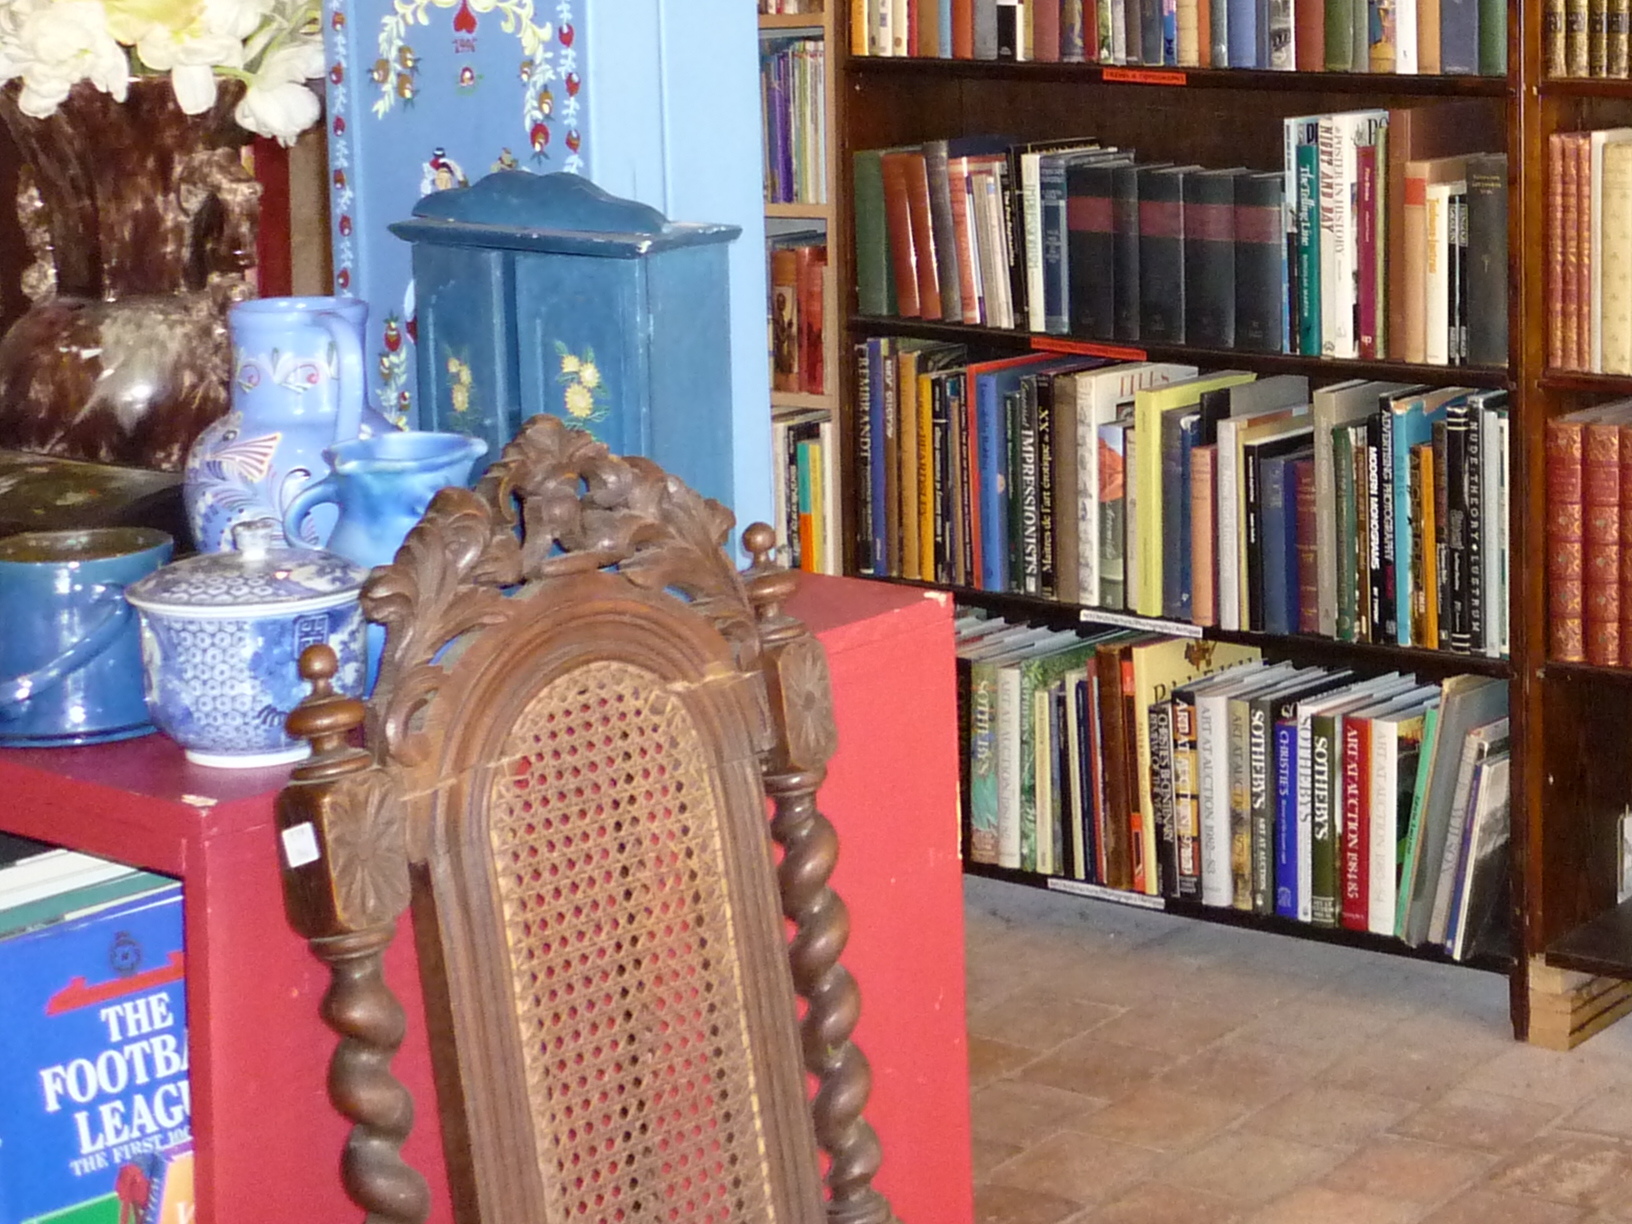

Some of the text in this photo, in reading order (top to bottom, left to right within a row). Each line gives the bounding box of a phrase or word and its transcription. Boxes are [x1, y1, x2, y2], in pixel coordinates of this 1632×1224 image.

[1319, 124, 1334, 233] NIGHT AND DAY
[1333, 134, 1346, 256] POSTER HISTORY
[857, 356, 871, 459] REMBRANDT
[1020, 429, 1038, 575] IMPRESSIONISTS
[1368, 445, 1380, 570] MODERN MONOGRAMS
[1382, 409, 1394, 561] ADVERTISING PHOTOGRAPHY
[1469, 555, 1482, 632] LUSTRUM
[976, 679, 990, 775] SOTHEBY'S
[1250, 709, 1267, 809] SOTHEBY'S
[1277, 729, 1290, 796] CHRISTIE'S
[1203, 757, 1215, 821] AUCTION
[1313, 735, 1329, 840] SOTHEBY'S
[1346, 724, 1359, 851] ART AT AUCTION
[1259, 851, 1267, 891] AUCTION
[100, 992, 174, 1042] THE
[39, 1033, 190, 1113] FOOTB
[69, 1134, 165, 1177] THE FIRST
